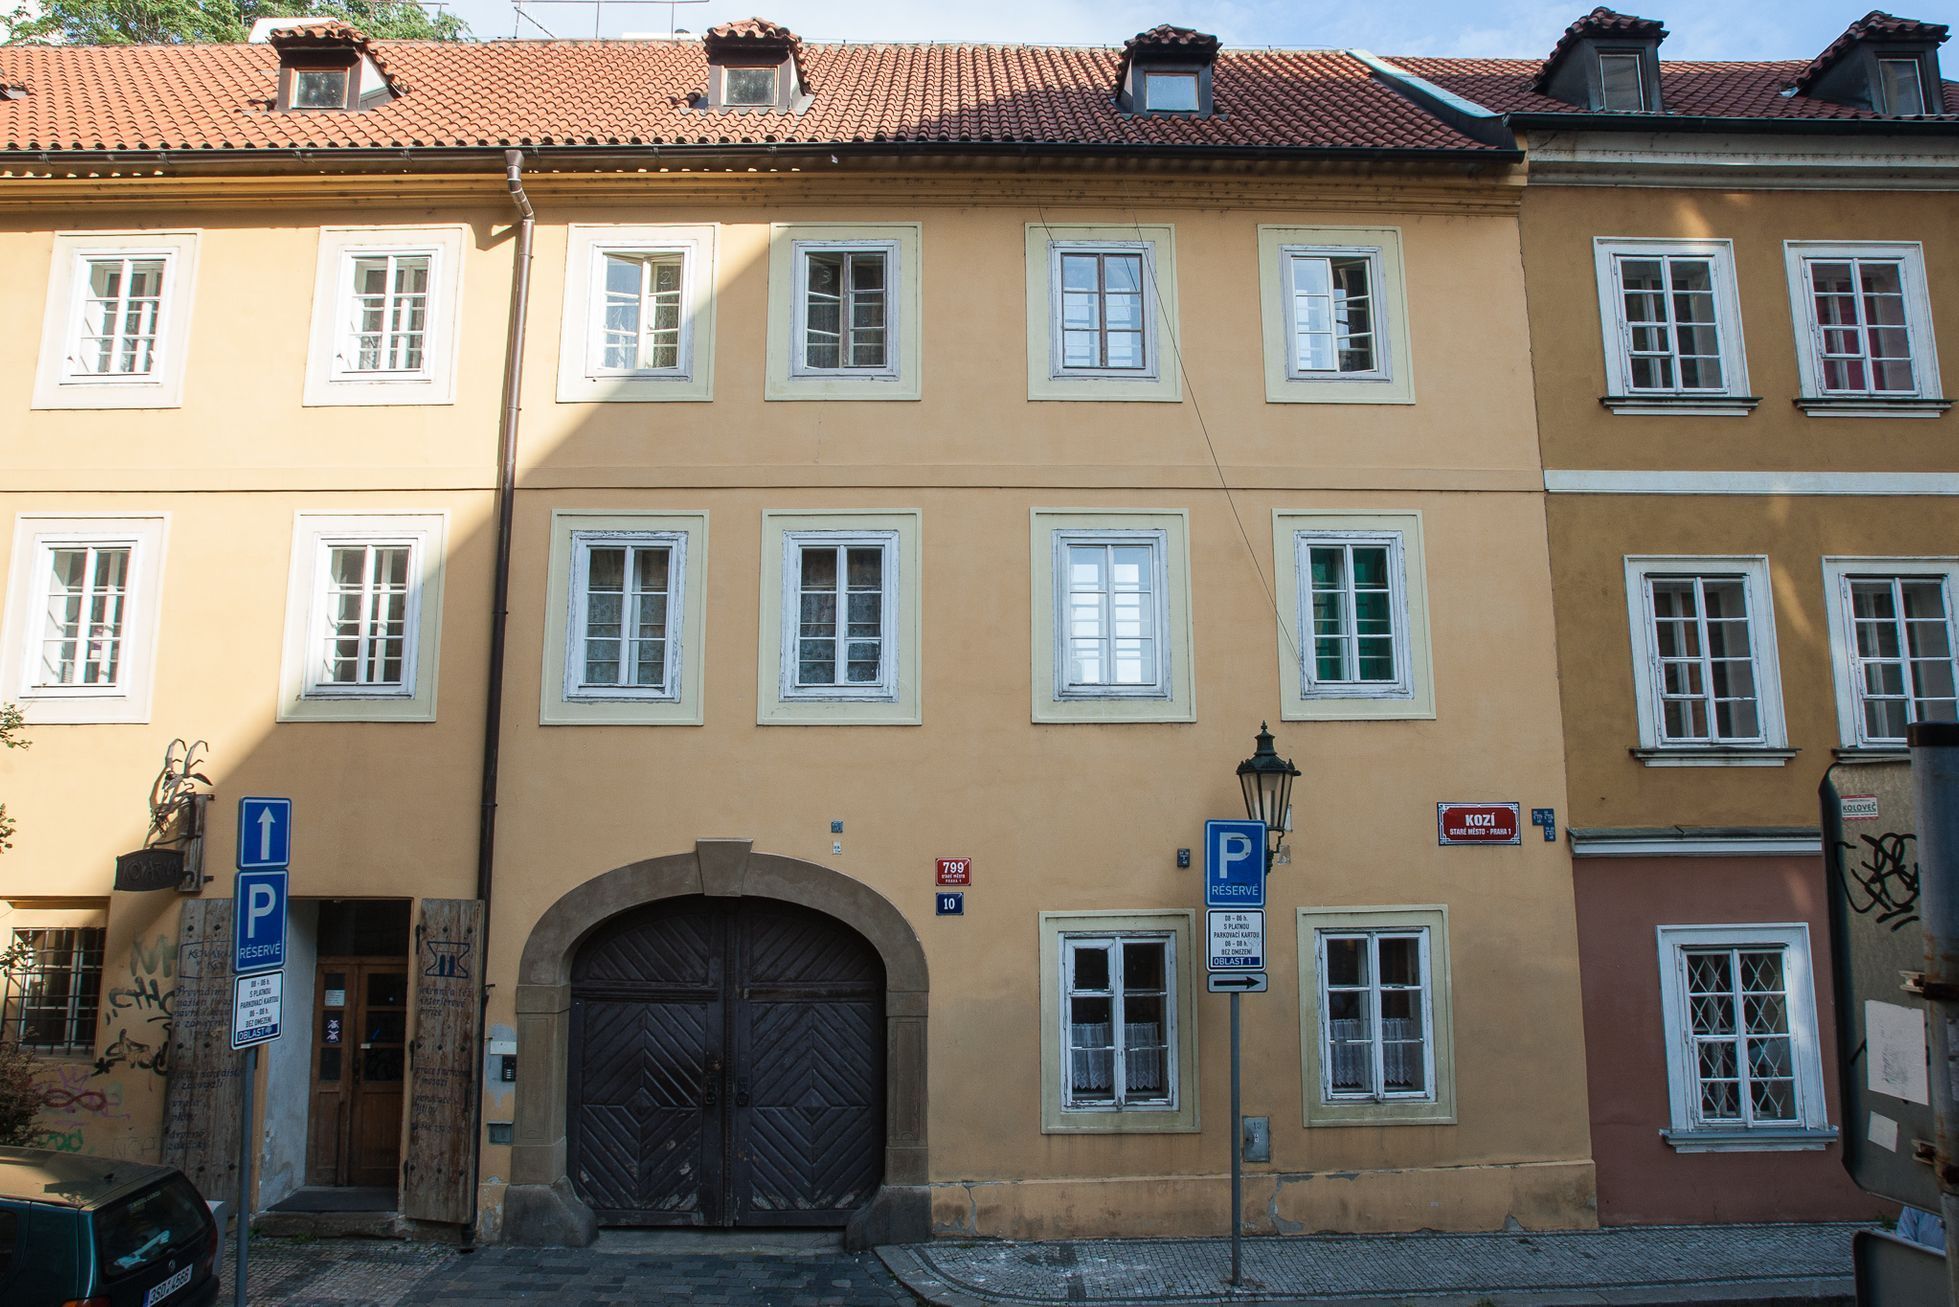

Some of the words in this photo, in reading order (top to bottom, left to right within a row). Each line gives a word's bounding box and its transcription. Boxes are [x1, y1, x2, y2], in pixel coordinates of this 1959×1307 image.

[660, 271, 673, 285] 2
[1842, 801, 1877, 812] KOLOVEČ
[1465, 812, 1496, 826] KOZÍ
[1450, 827, 1466, 835] STARÉ
[1467, 827, 1485, 835] MĚSTO
[1219, 832, 1252, 878] P
[943, 861, 964, 873] 799
[1211, 883, 1259, 896] RÉSERVÉ
[943, 898, 955, 910] 10
[247, 883, 277, 939] P
[239, 940, 281, 959] RÉSERVÉ
[1213, 957, 1244, 965] OBLAST
[238, 1027, 265, 1040] OBLAST
